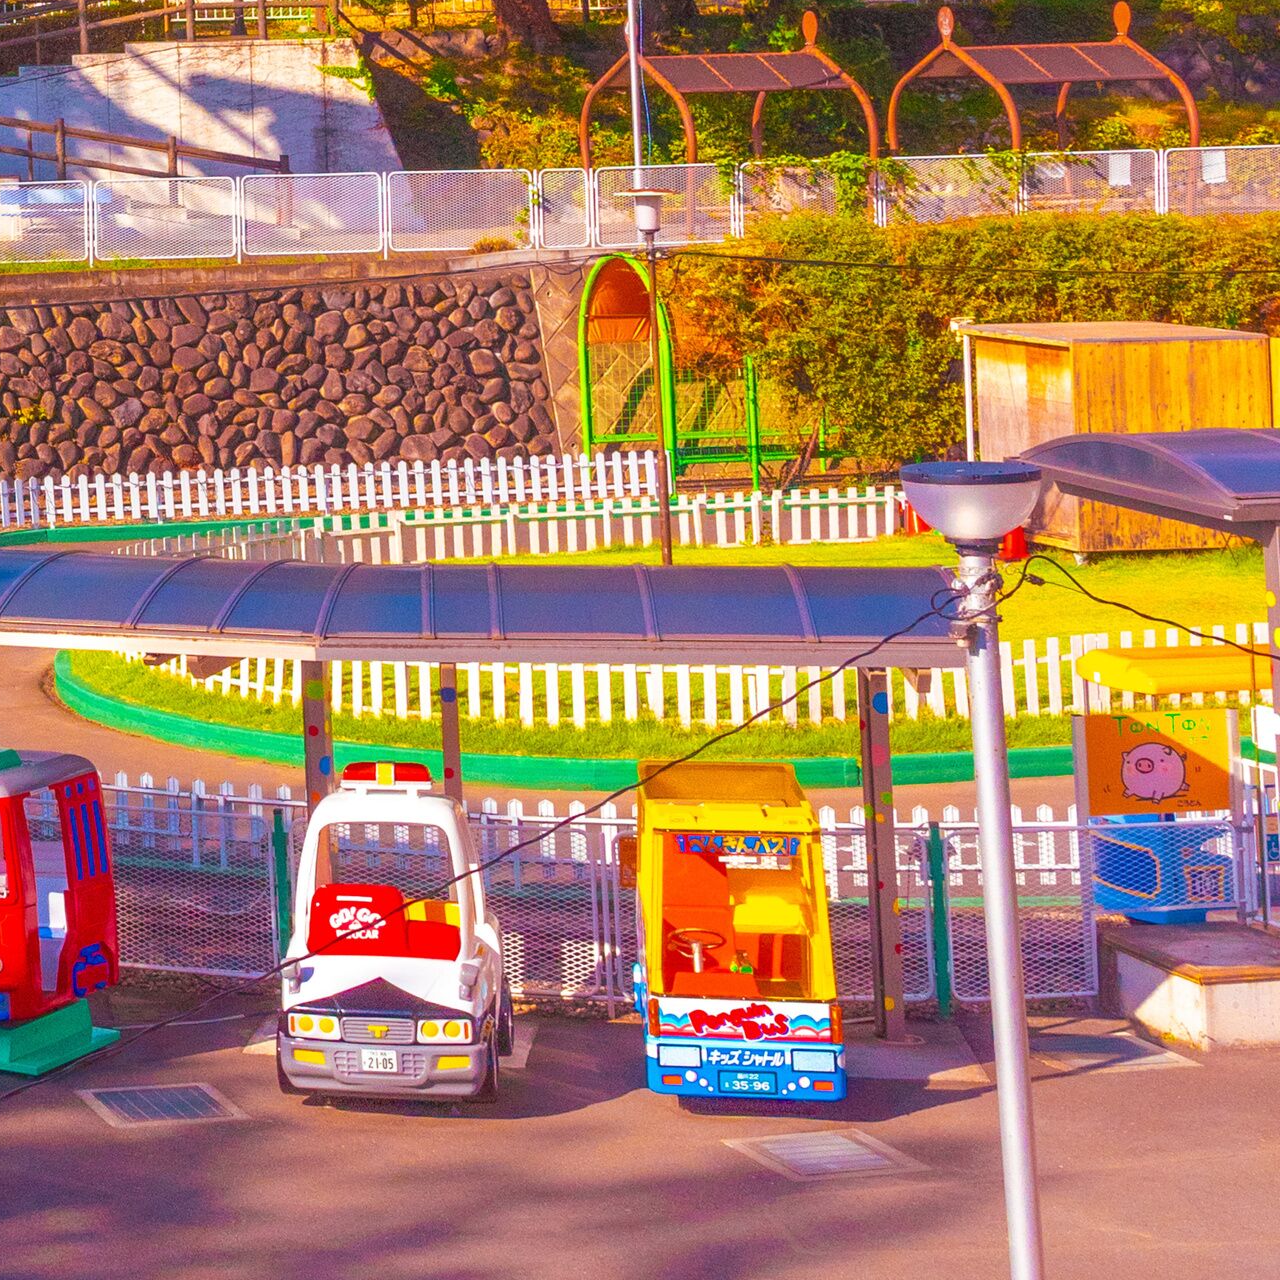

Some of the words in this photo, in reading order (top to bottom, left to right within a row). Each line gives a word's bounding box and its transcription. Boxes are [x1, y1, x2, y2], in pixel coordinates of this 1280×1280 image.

[368, 1057, 394, 1070] 21-05
[708, 1049, 742, 1066] キッズ
[742, 1050, 784, 1067] シャトル
[732, 1080, 771, 1091] 35-96
